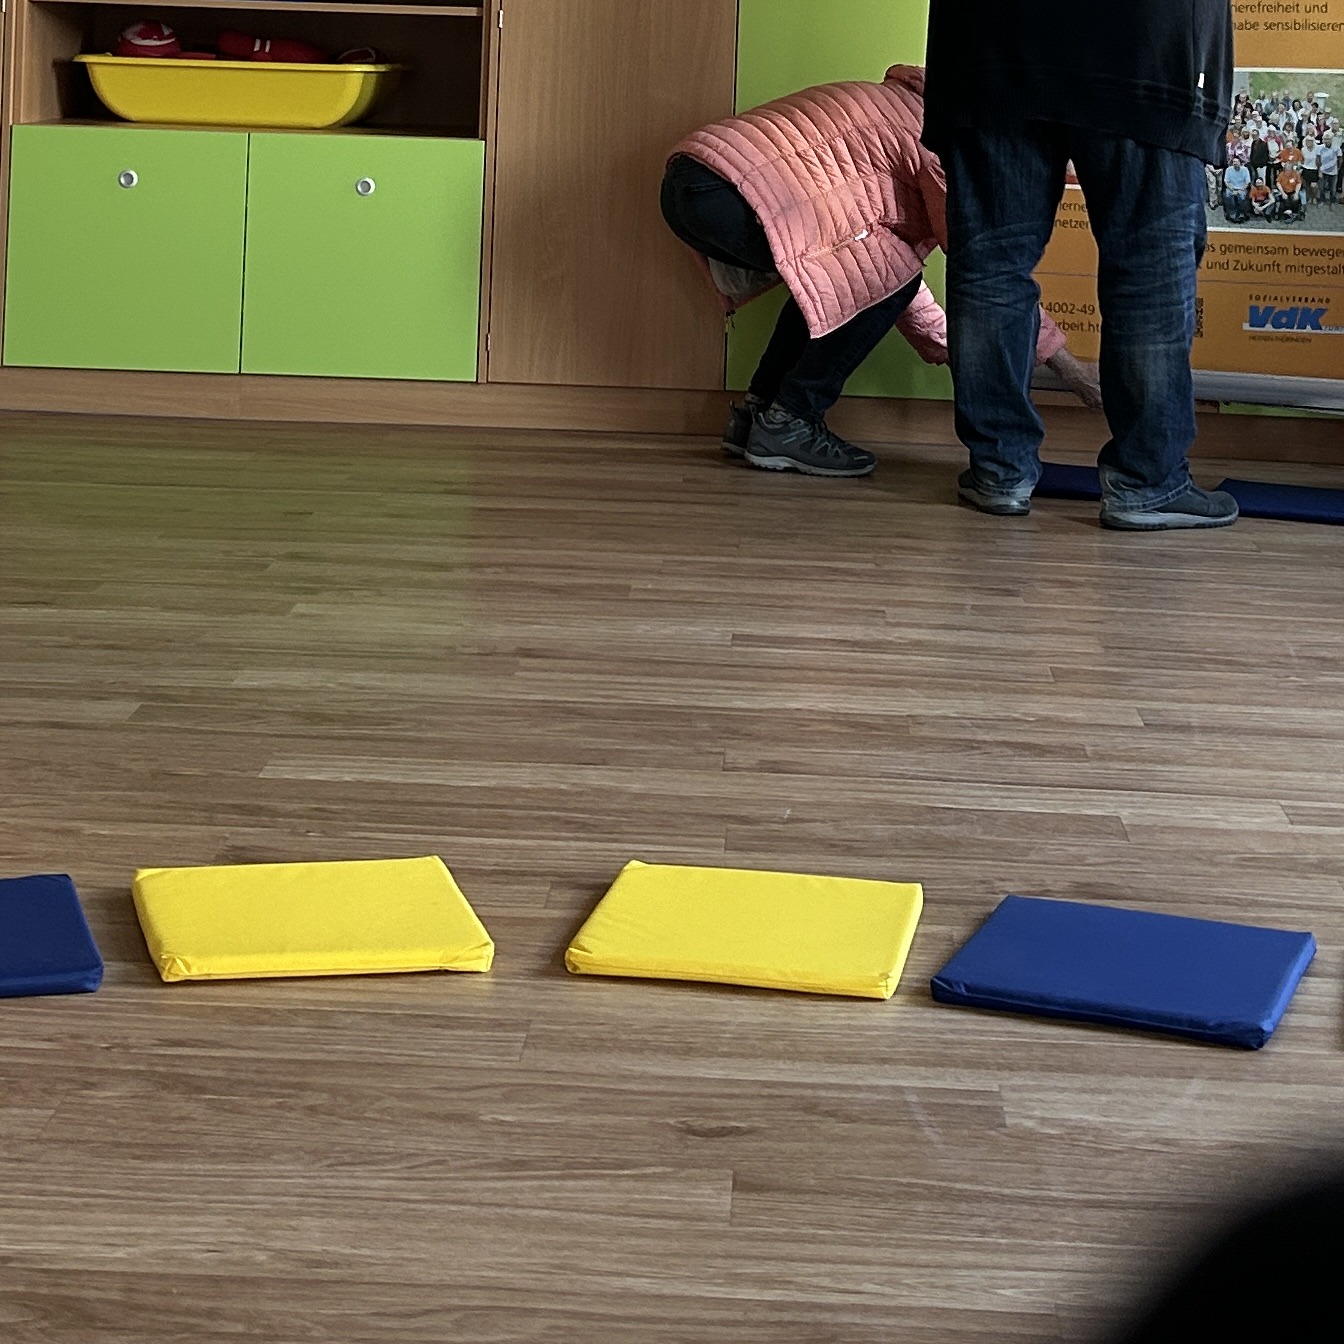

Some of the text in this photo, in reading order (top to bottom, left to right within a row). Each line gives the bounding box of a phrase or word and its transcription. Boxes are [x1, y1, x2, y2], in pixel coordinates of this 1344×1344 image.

[1304, 2, 1328, 14] und
[1219, 243, 1289, 257] gemeinsam
[1206, 260, 1229, 271] und
[1233, 260, 1282, 274] Zukunft
[1248, 304, 1328, 331] VdK
